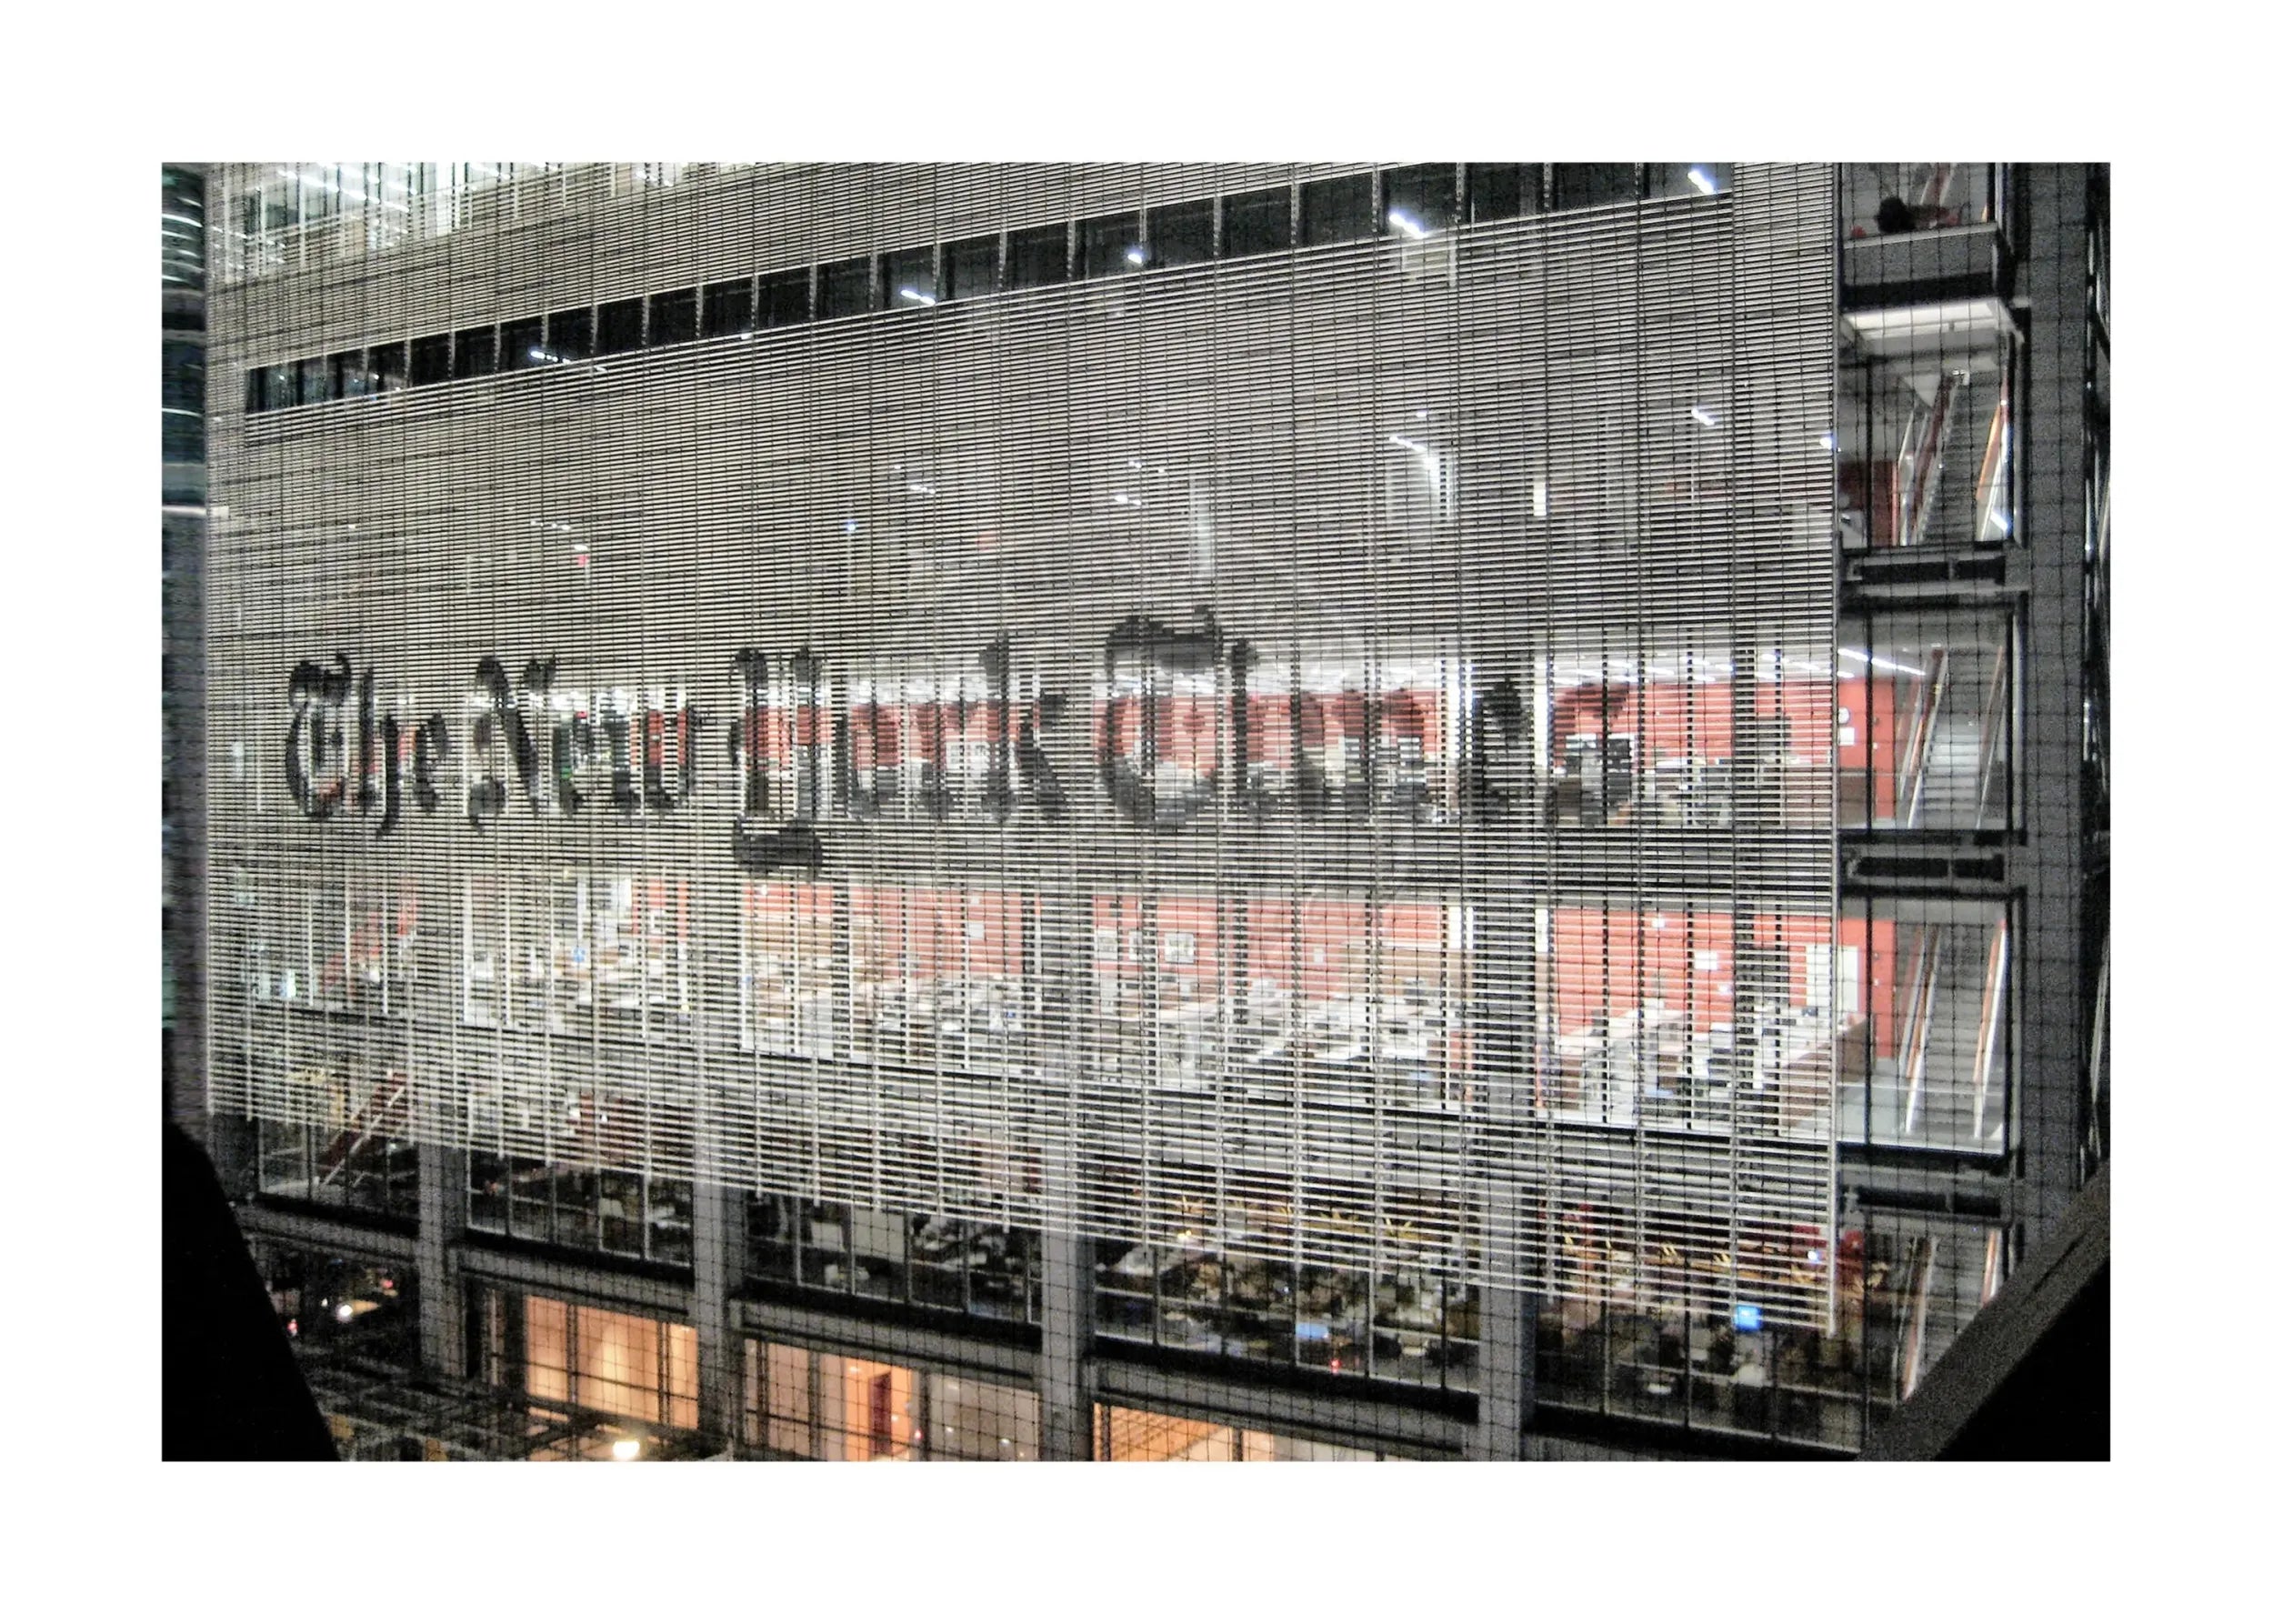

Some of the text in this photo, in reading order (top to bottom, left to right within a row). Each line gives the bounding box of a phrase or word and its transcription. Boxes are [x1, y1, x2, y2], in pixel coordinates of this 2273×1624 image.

[285, 604, 1632, 868] The New York Times
